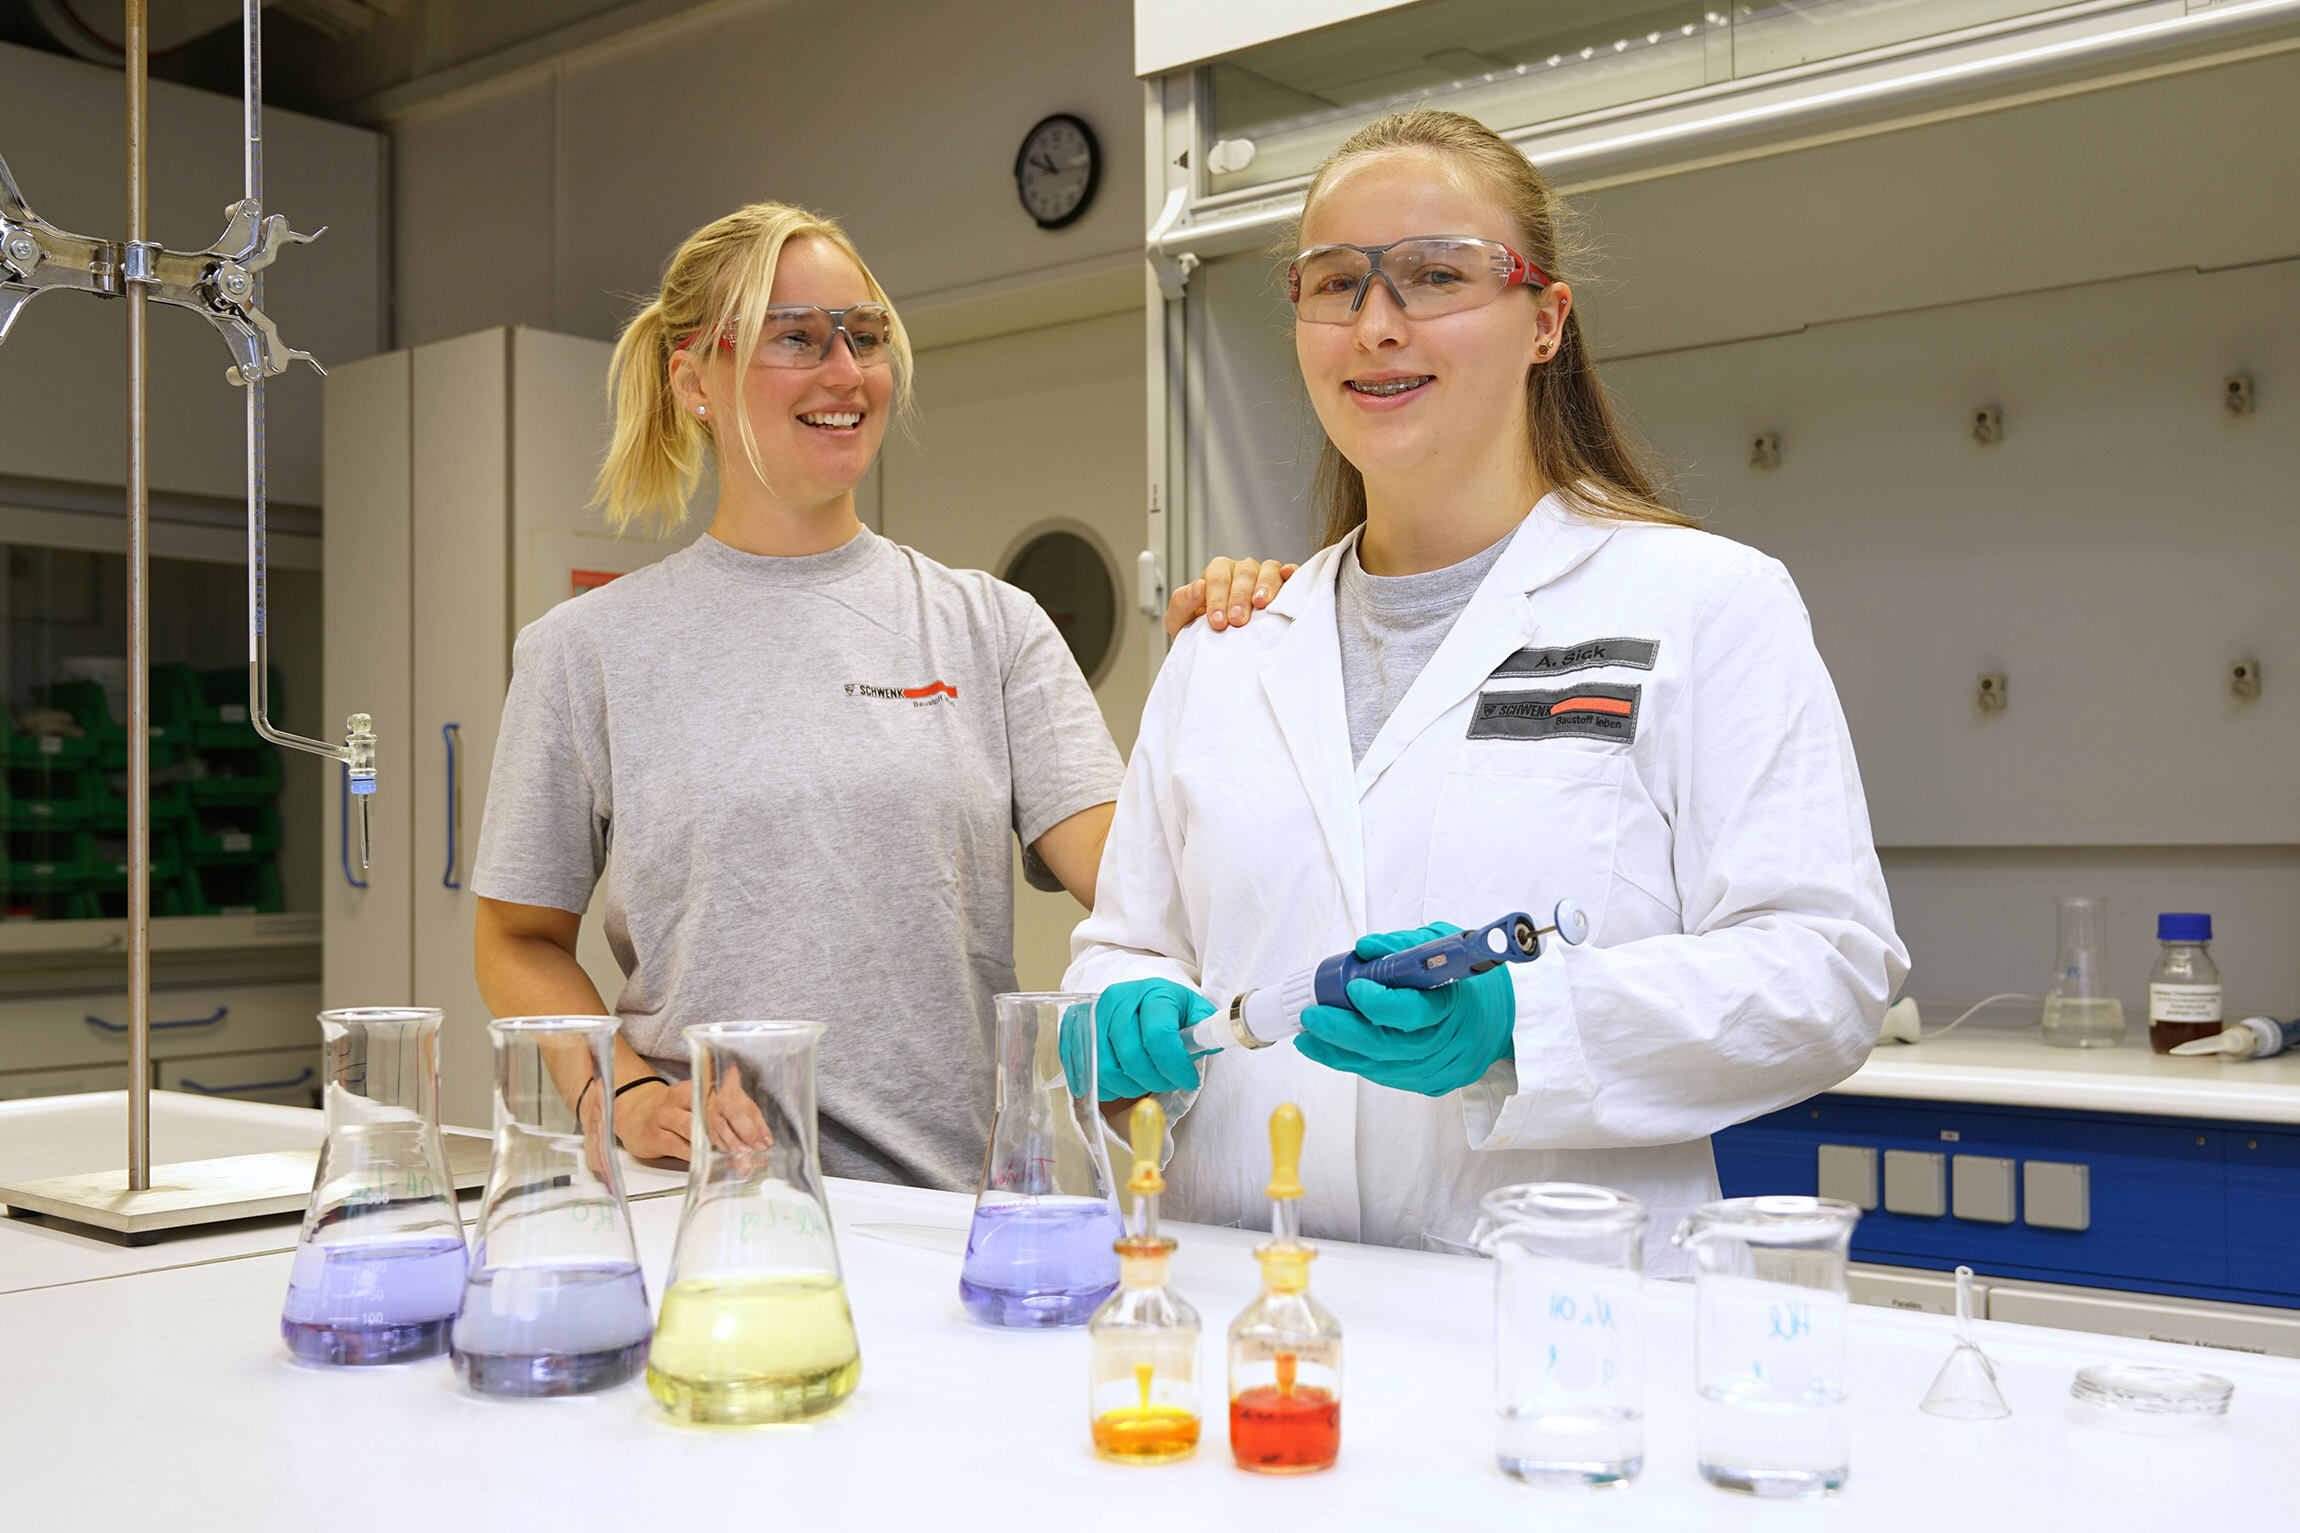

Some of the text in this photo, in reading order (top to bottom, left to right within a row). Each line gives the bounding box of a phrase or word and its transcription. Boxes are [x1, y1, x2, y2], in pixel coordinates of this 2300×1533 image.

[1535, 645, 1607, 668] A. Sick
[860, 685, 905, 699] SCHWENK
[1499, 703, 1552, 718] SCHWENK
[1555, 714, 1622, 730] Baustoff leben
